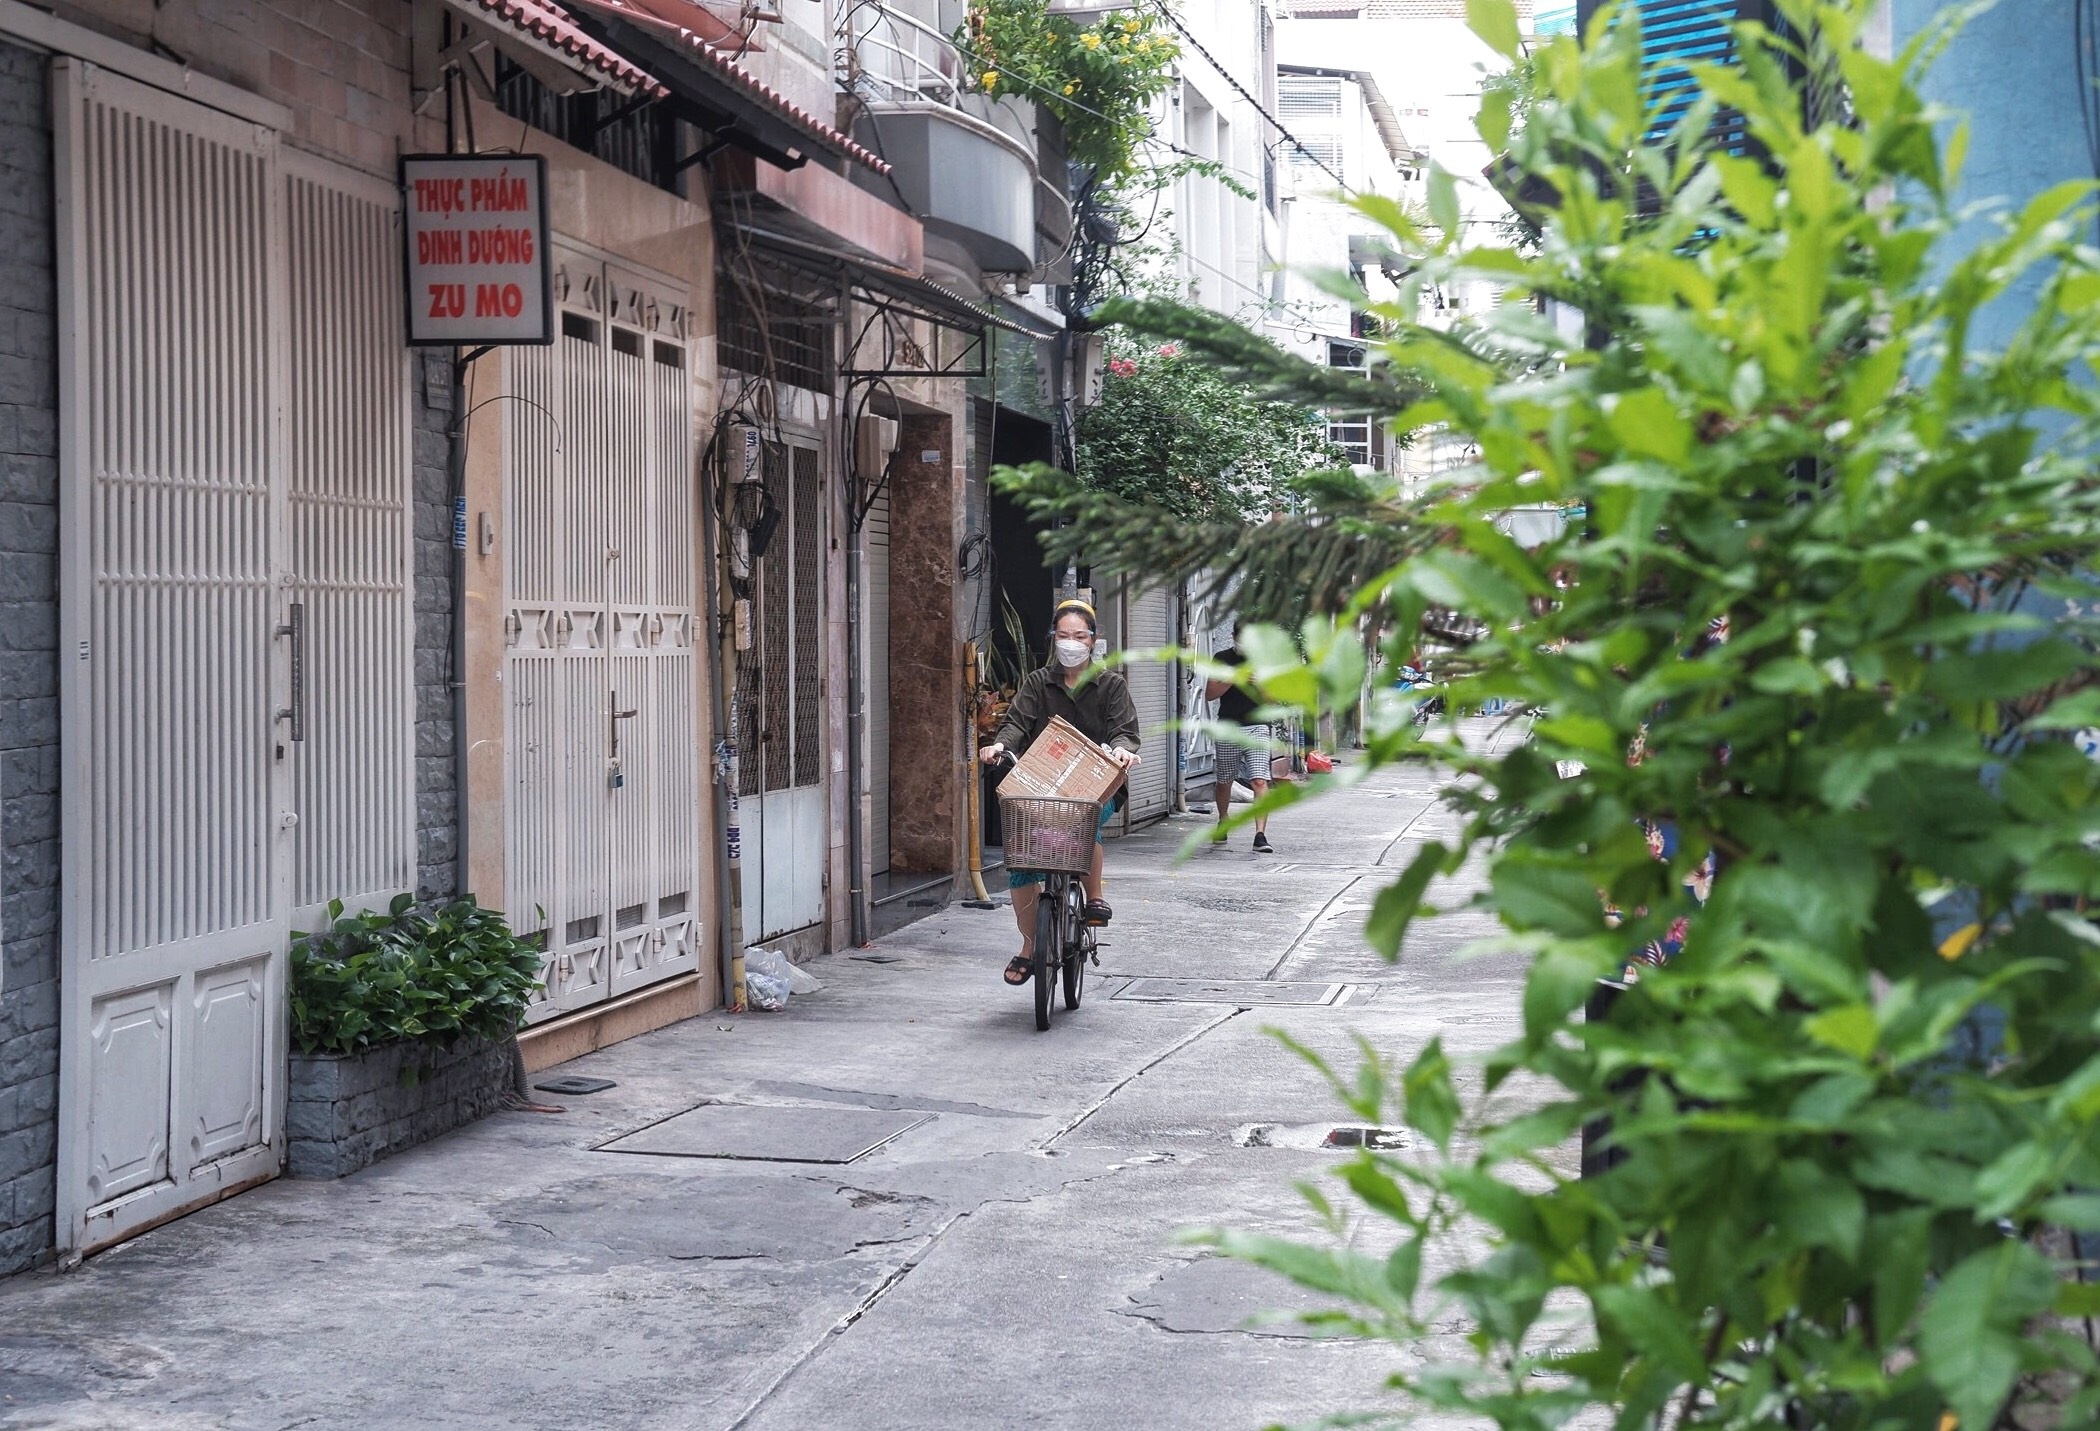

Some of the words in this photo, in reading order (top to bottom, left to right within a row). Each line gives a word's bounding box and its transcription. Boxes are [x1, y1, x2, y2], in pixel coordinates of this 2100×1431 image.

[414, 178, 464, 219] THỰC
[417, 231, 462, 265] DINH
[428, 284, 466, 318] ZU
[475, 283, 523, 318] MO
